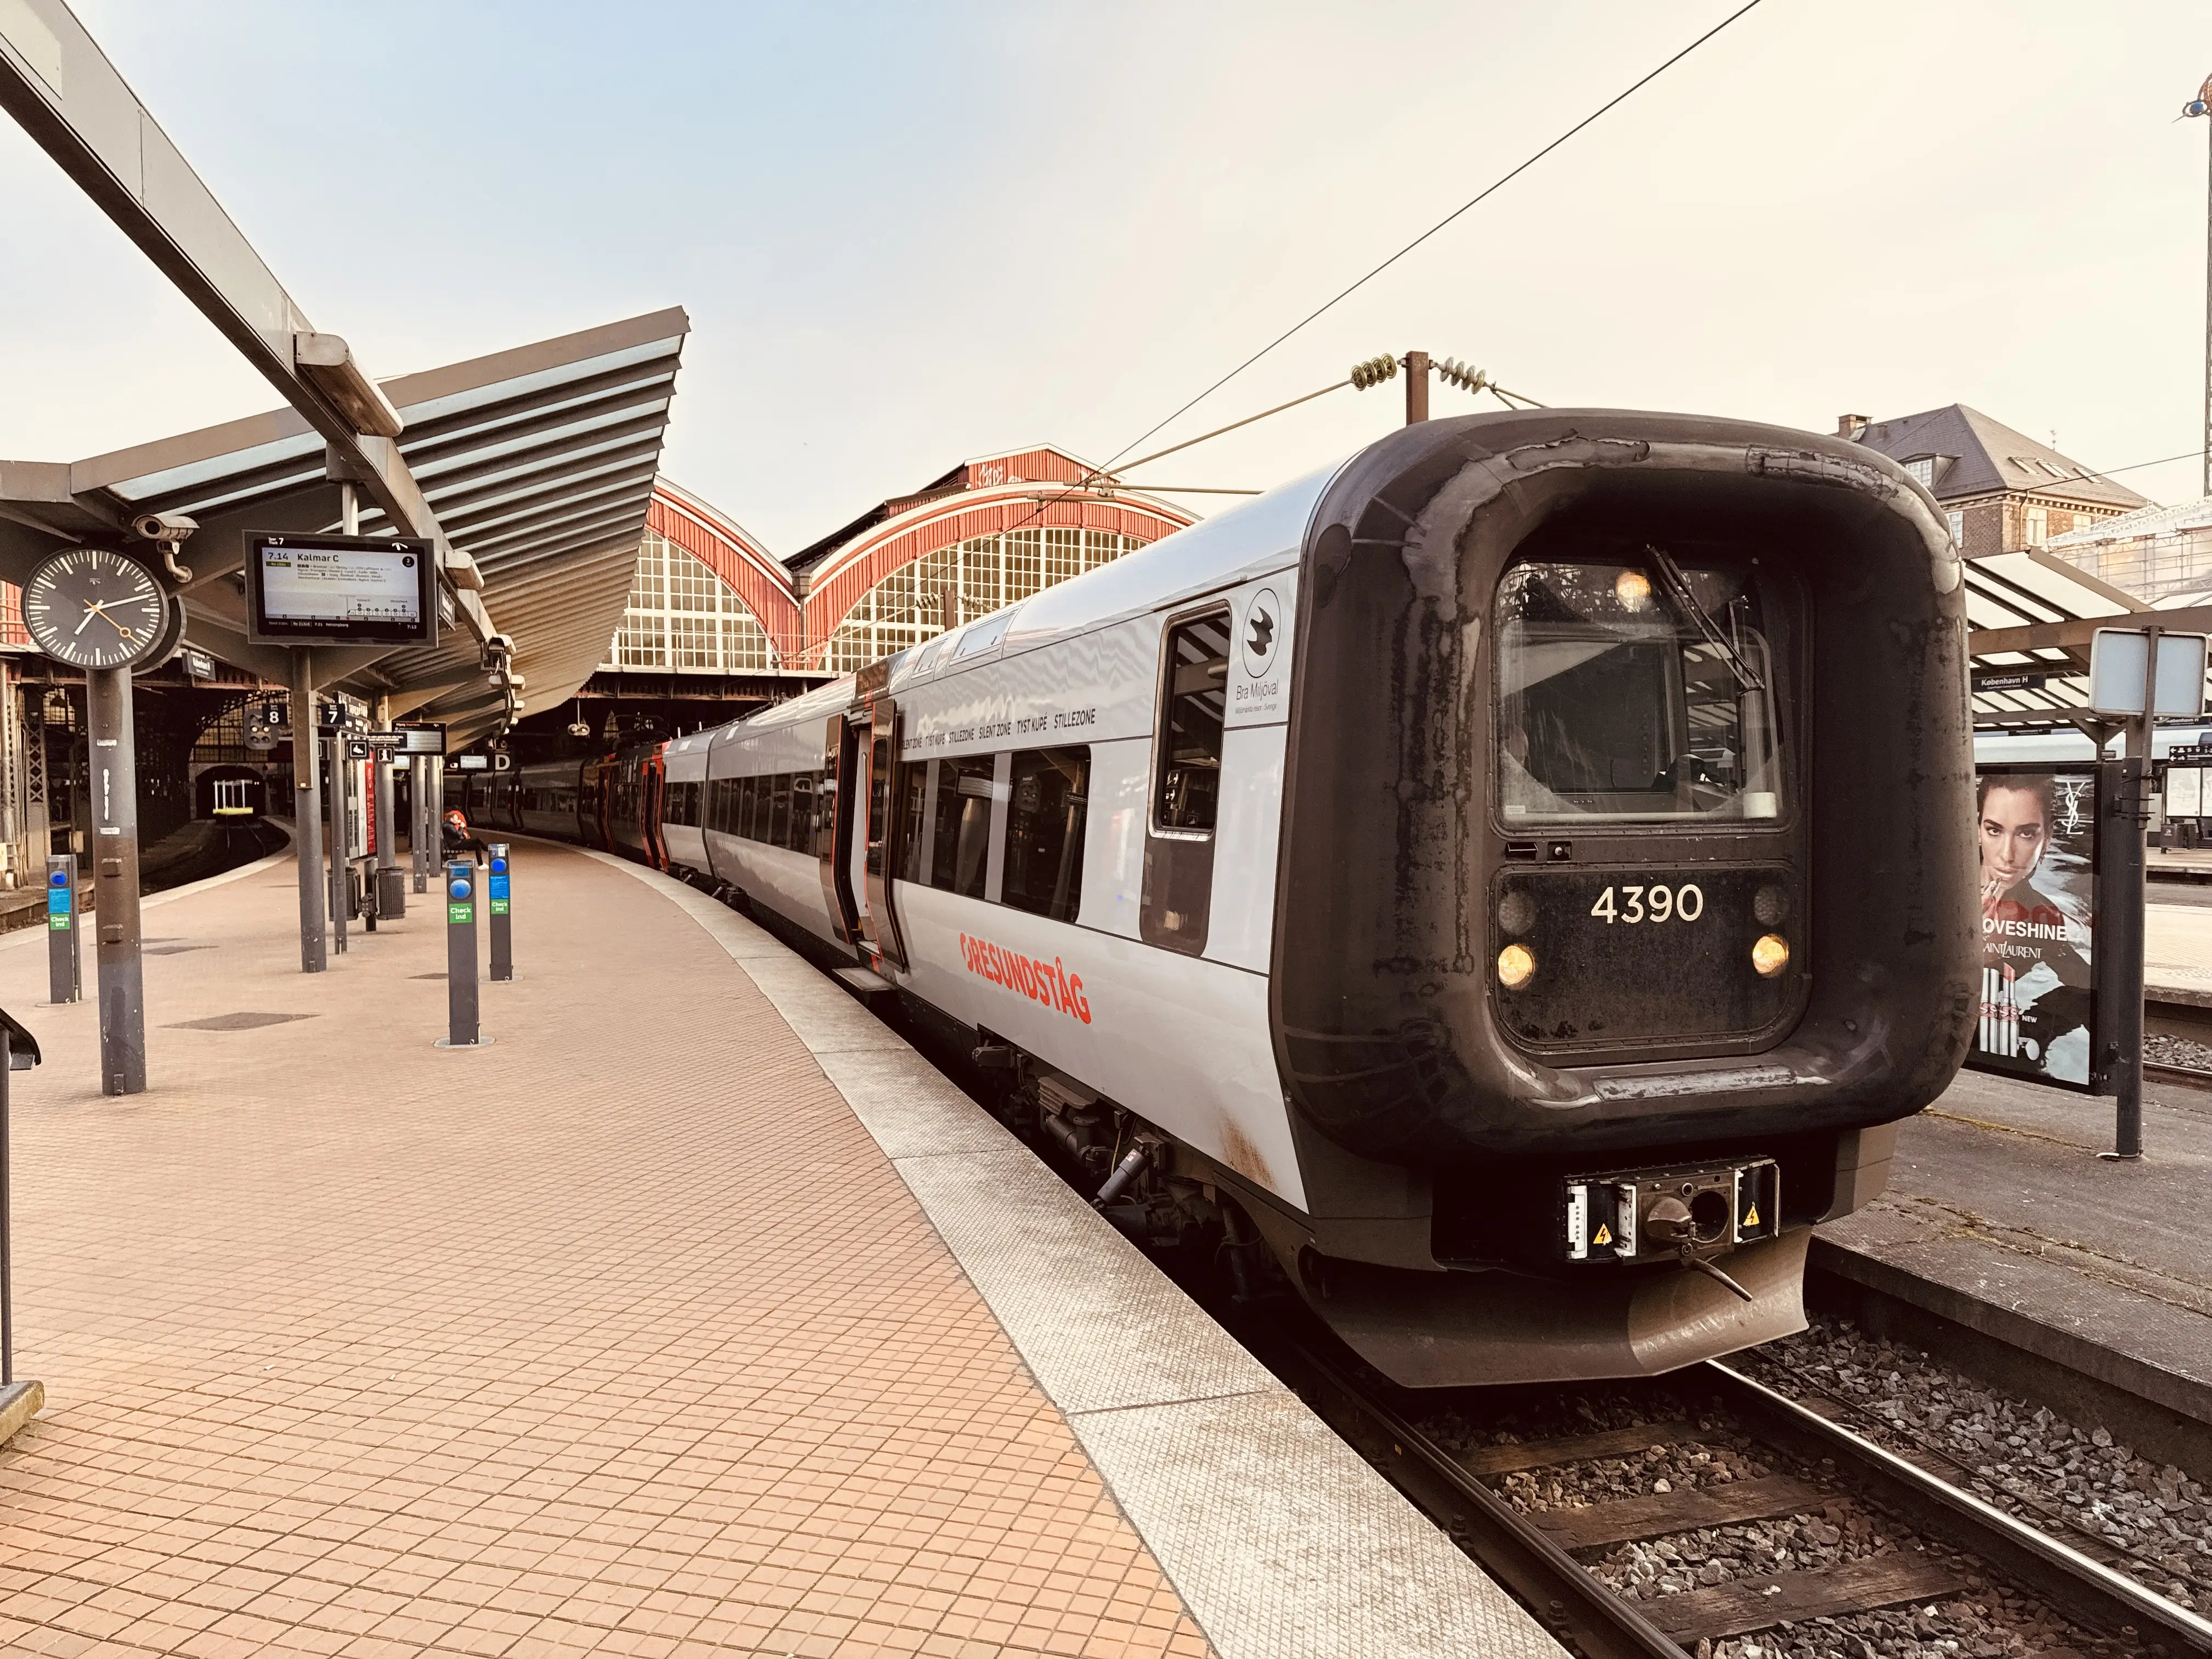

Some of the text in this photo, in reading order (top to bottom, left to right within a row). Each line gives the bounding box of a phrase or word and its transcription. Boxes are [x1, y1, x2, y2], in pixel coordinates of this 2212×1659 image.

[279, 537, 284, 545] 7
[268, 552, 289, 560] 7.14
[1236, 678, 1279, 701] Bra Miljöval
[1981, 677, 2021, 686] København
[269, 711, 279, 724] 8
[328, 711, 338, 724] 7
[949, 729, 974, 743] STILLEZONE
[979, 724, 996, 740] SILENT
[996, 722, 1011, 737] ZONE
[1017, 718, 1031, 734] TYST
[1031, 712, 1047, 732] KUPÉ
[1054, 708, 1096, 729] STILLEZONE
[495, 754, 510, 771] D
[2061, 781, 2086, 835] YSL
[1591, 884, 1703, 924] 4390
[1982, 918, 2068, 941] OVESHINE
[960, 932, 1092, 1025] ØRESUNDSTÅG
[2022, 1015, 2038, 1023] NEW
